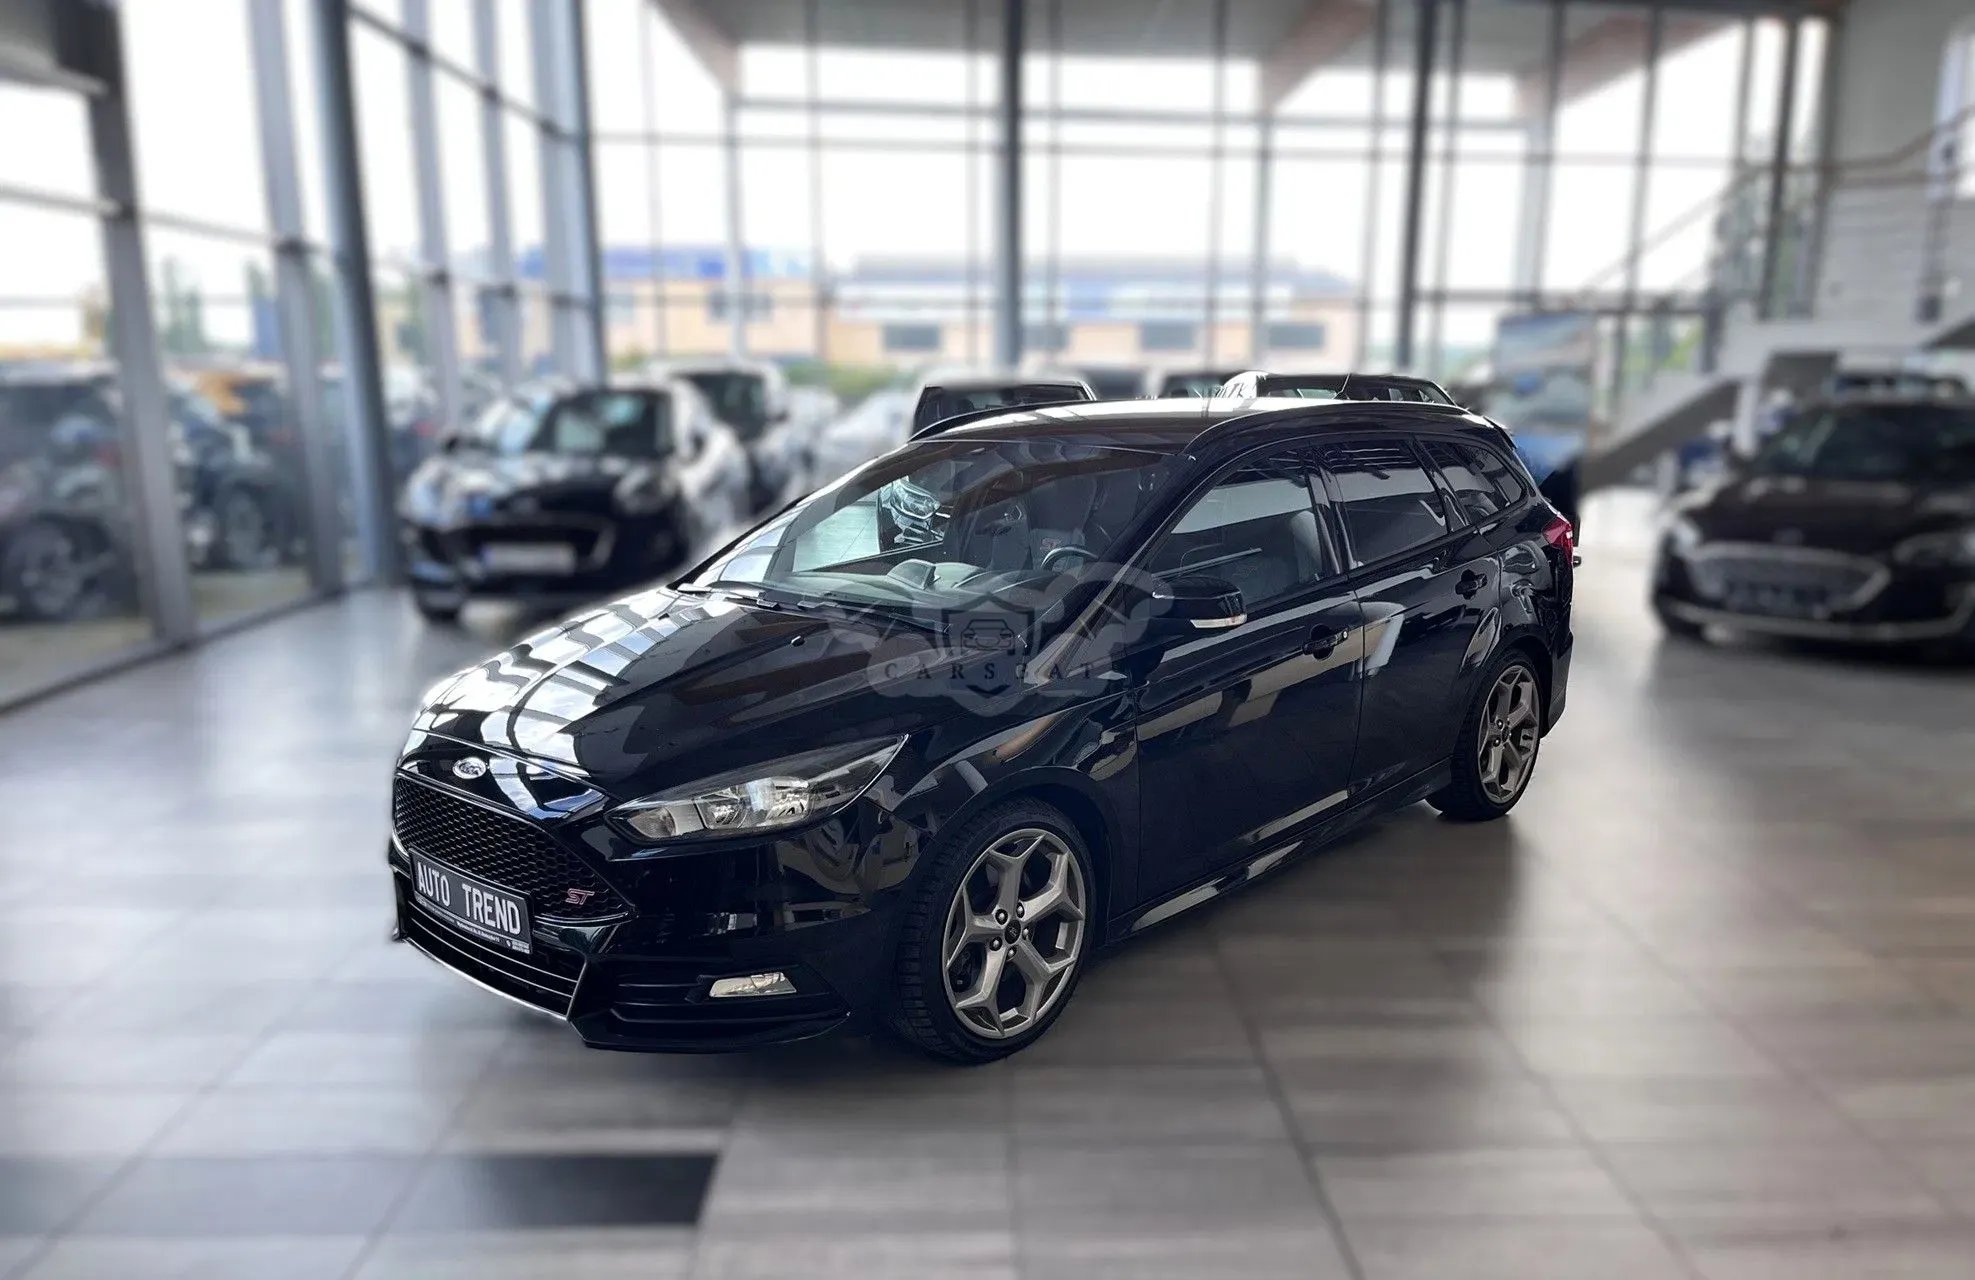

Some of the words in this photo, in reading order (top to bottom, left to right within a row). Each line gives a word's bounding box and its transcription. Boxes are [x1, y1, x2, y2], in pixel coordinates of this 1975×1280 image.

[417, 861, 451, 907] AUTO
[461, 883, 521, 935] TREND
[565, 887, 596, 905] ST
